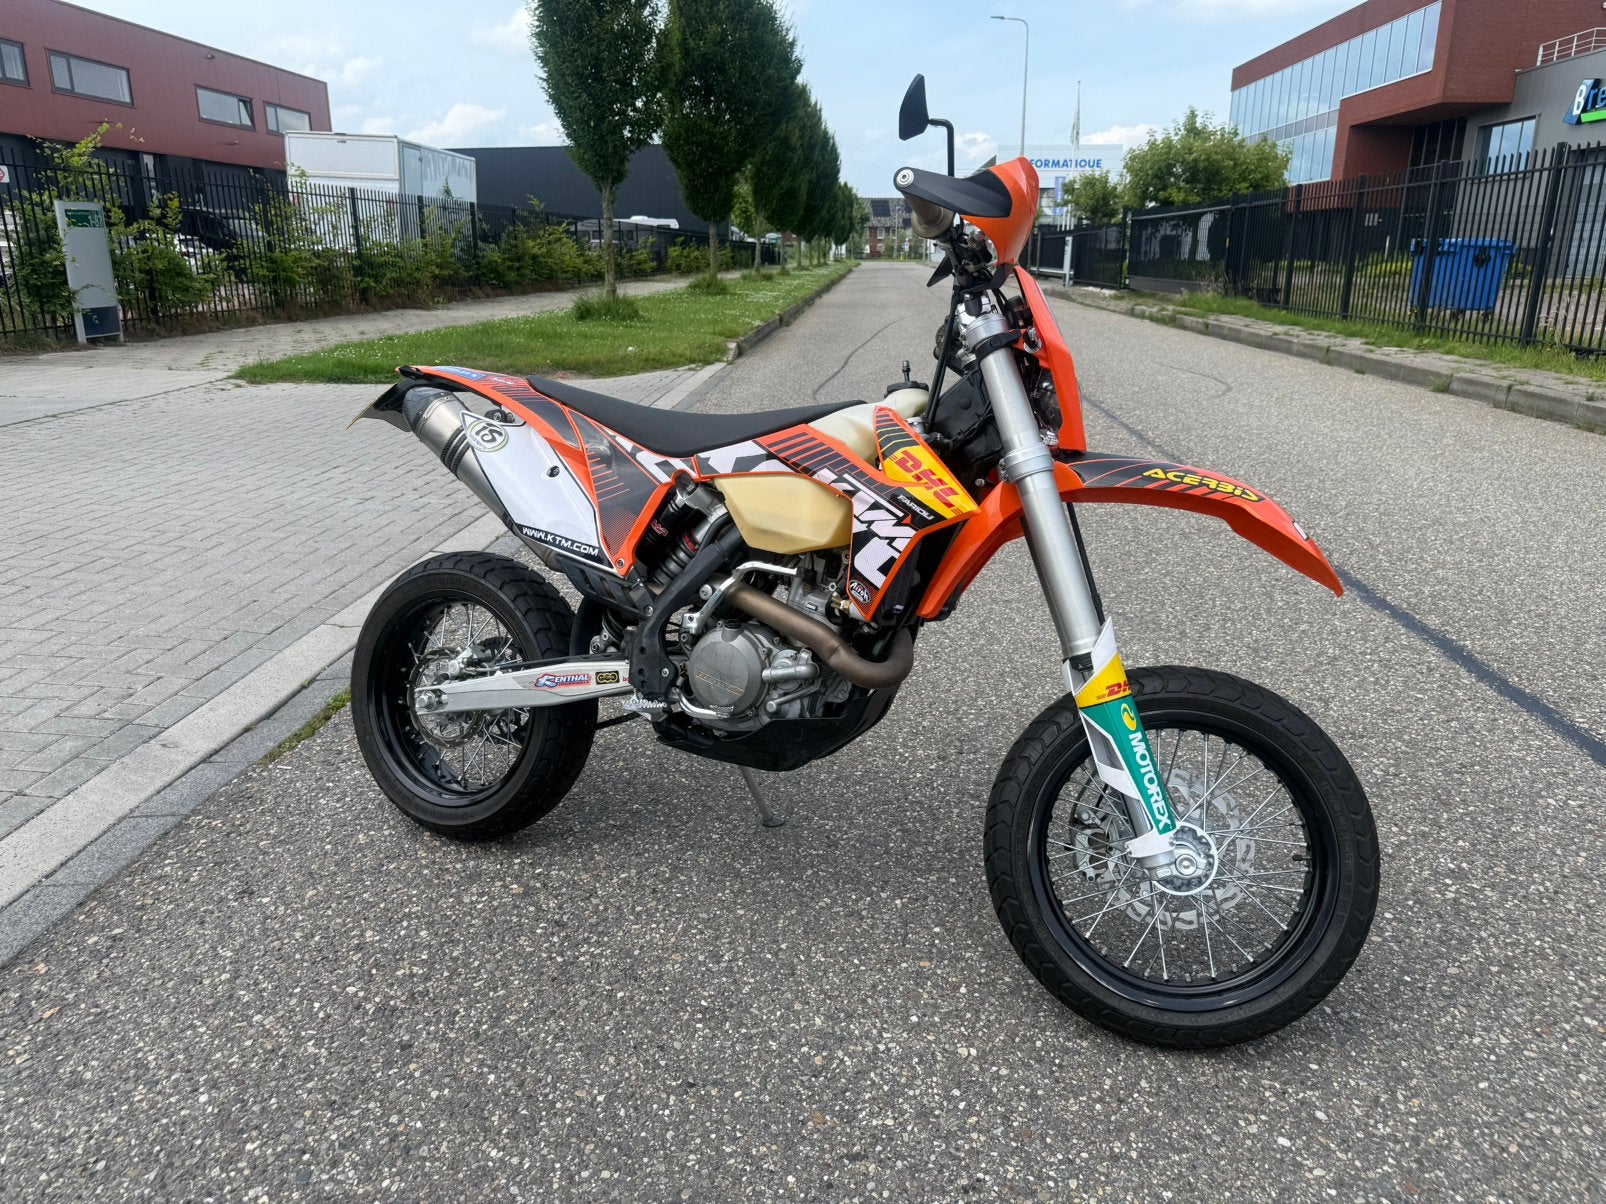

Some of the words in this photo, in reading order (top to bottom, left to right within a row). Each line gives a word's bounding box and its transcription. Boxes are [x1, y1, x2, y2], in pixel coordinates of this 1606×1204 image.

[1029, 158, 1103, 169] FORMATIQUE
[894, 449, 961, 510] DHL
[522, 526, 599, 557] WWW.KTM.COM
[1105, 680, 1131, 698] DH
[1128, 731, 1172, 831] MOTOREX
